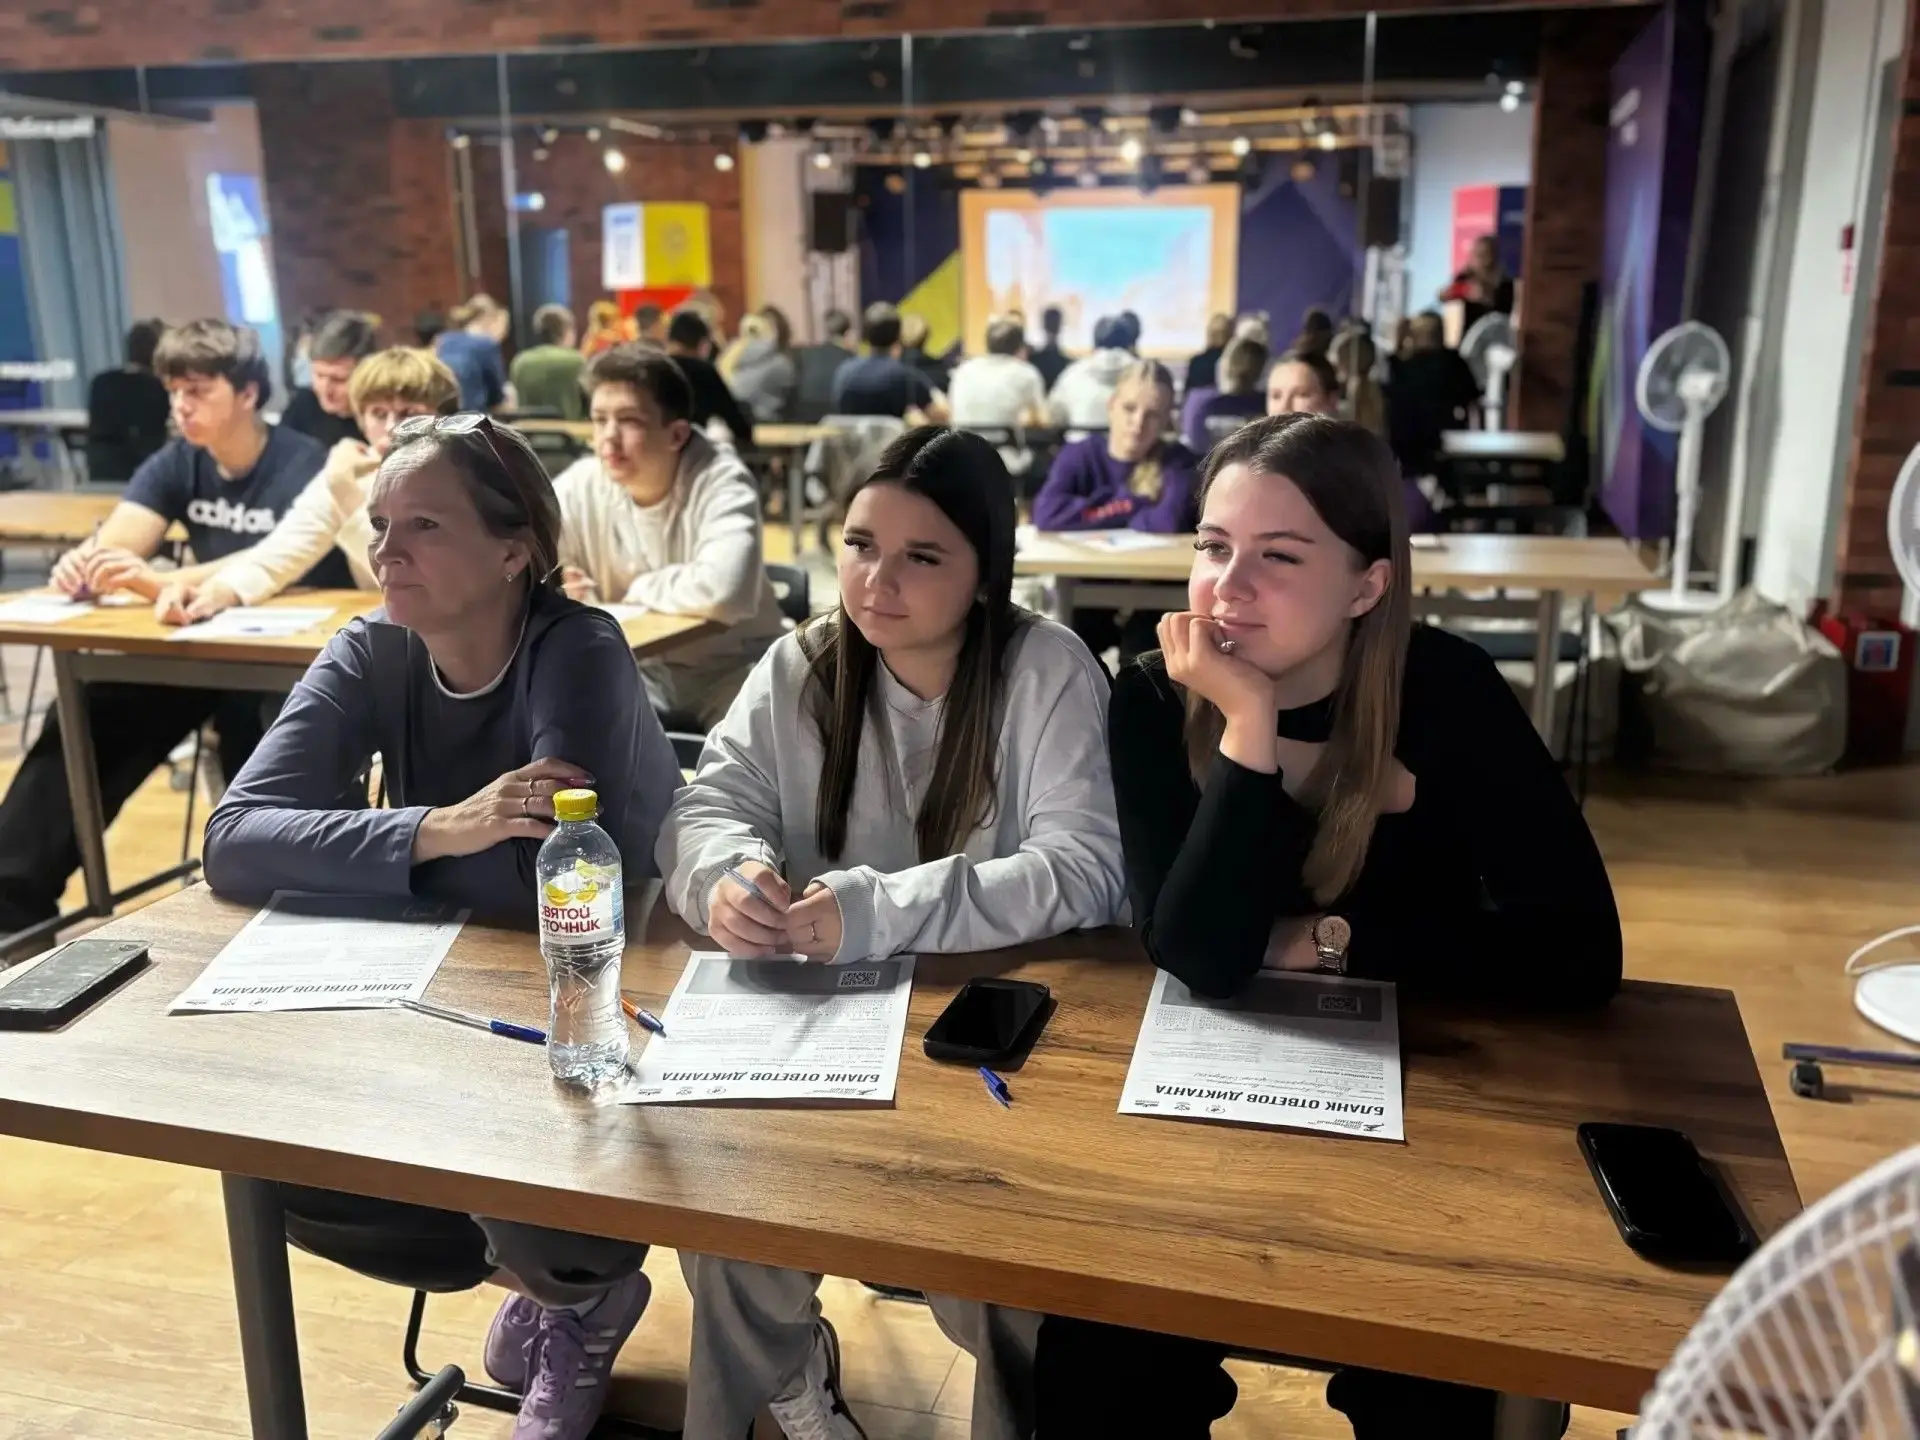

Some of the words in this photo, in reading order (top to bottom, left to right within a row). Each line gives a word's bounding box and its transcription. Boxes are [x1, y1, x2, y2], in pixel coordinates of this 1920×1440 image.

[212, 984, 293, 995] ДИКТАНТА
[293, 983, 358, 993] ОТВЕТОВ
[361, 982, 413, 991] БЛАНК
[662, 1071, 748, 1083] ДИКТАНТА
[750, 1072, 820, 1083] ОТВЕТОВ
[824, 1073, 880, 1083] БЛАНК
[1155, 1084, 1244, 1102] ДИКТАНТА
[1246, 1093, 1320, 1110] ОТВЕТОВ
[1325, 1101, 1385, 1116] БЛАНК
